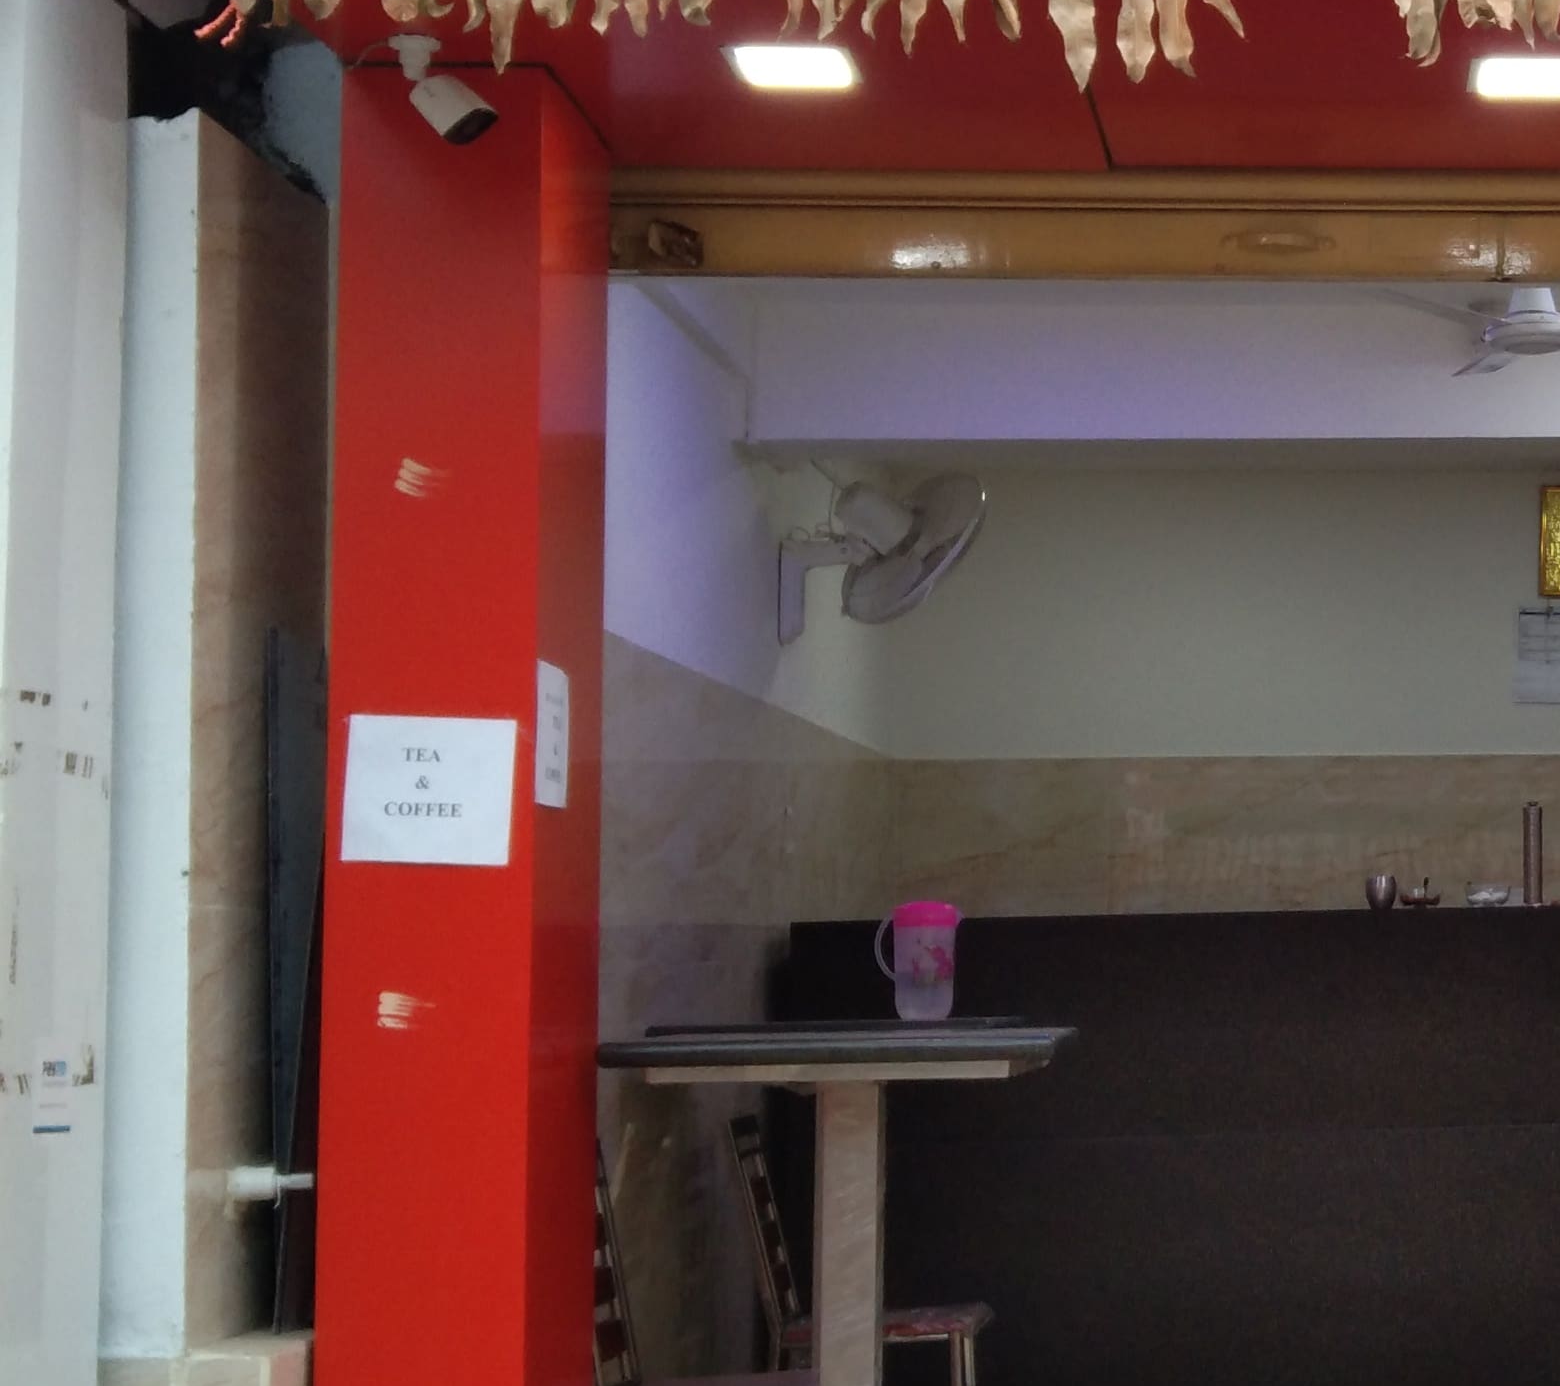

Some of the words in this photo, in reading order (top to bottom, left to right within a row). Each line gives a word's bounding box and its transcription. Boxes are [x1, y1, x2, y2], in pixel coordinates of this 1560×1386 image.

[402, 747, 442, 763] TEA
[415, 775, 430, 790] &
[383, 800, 463, 818] COFFEE
